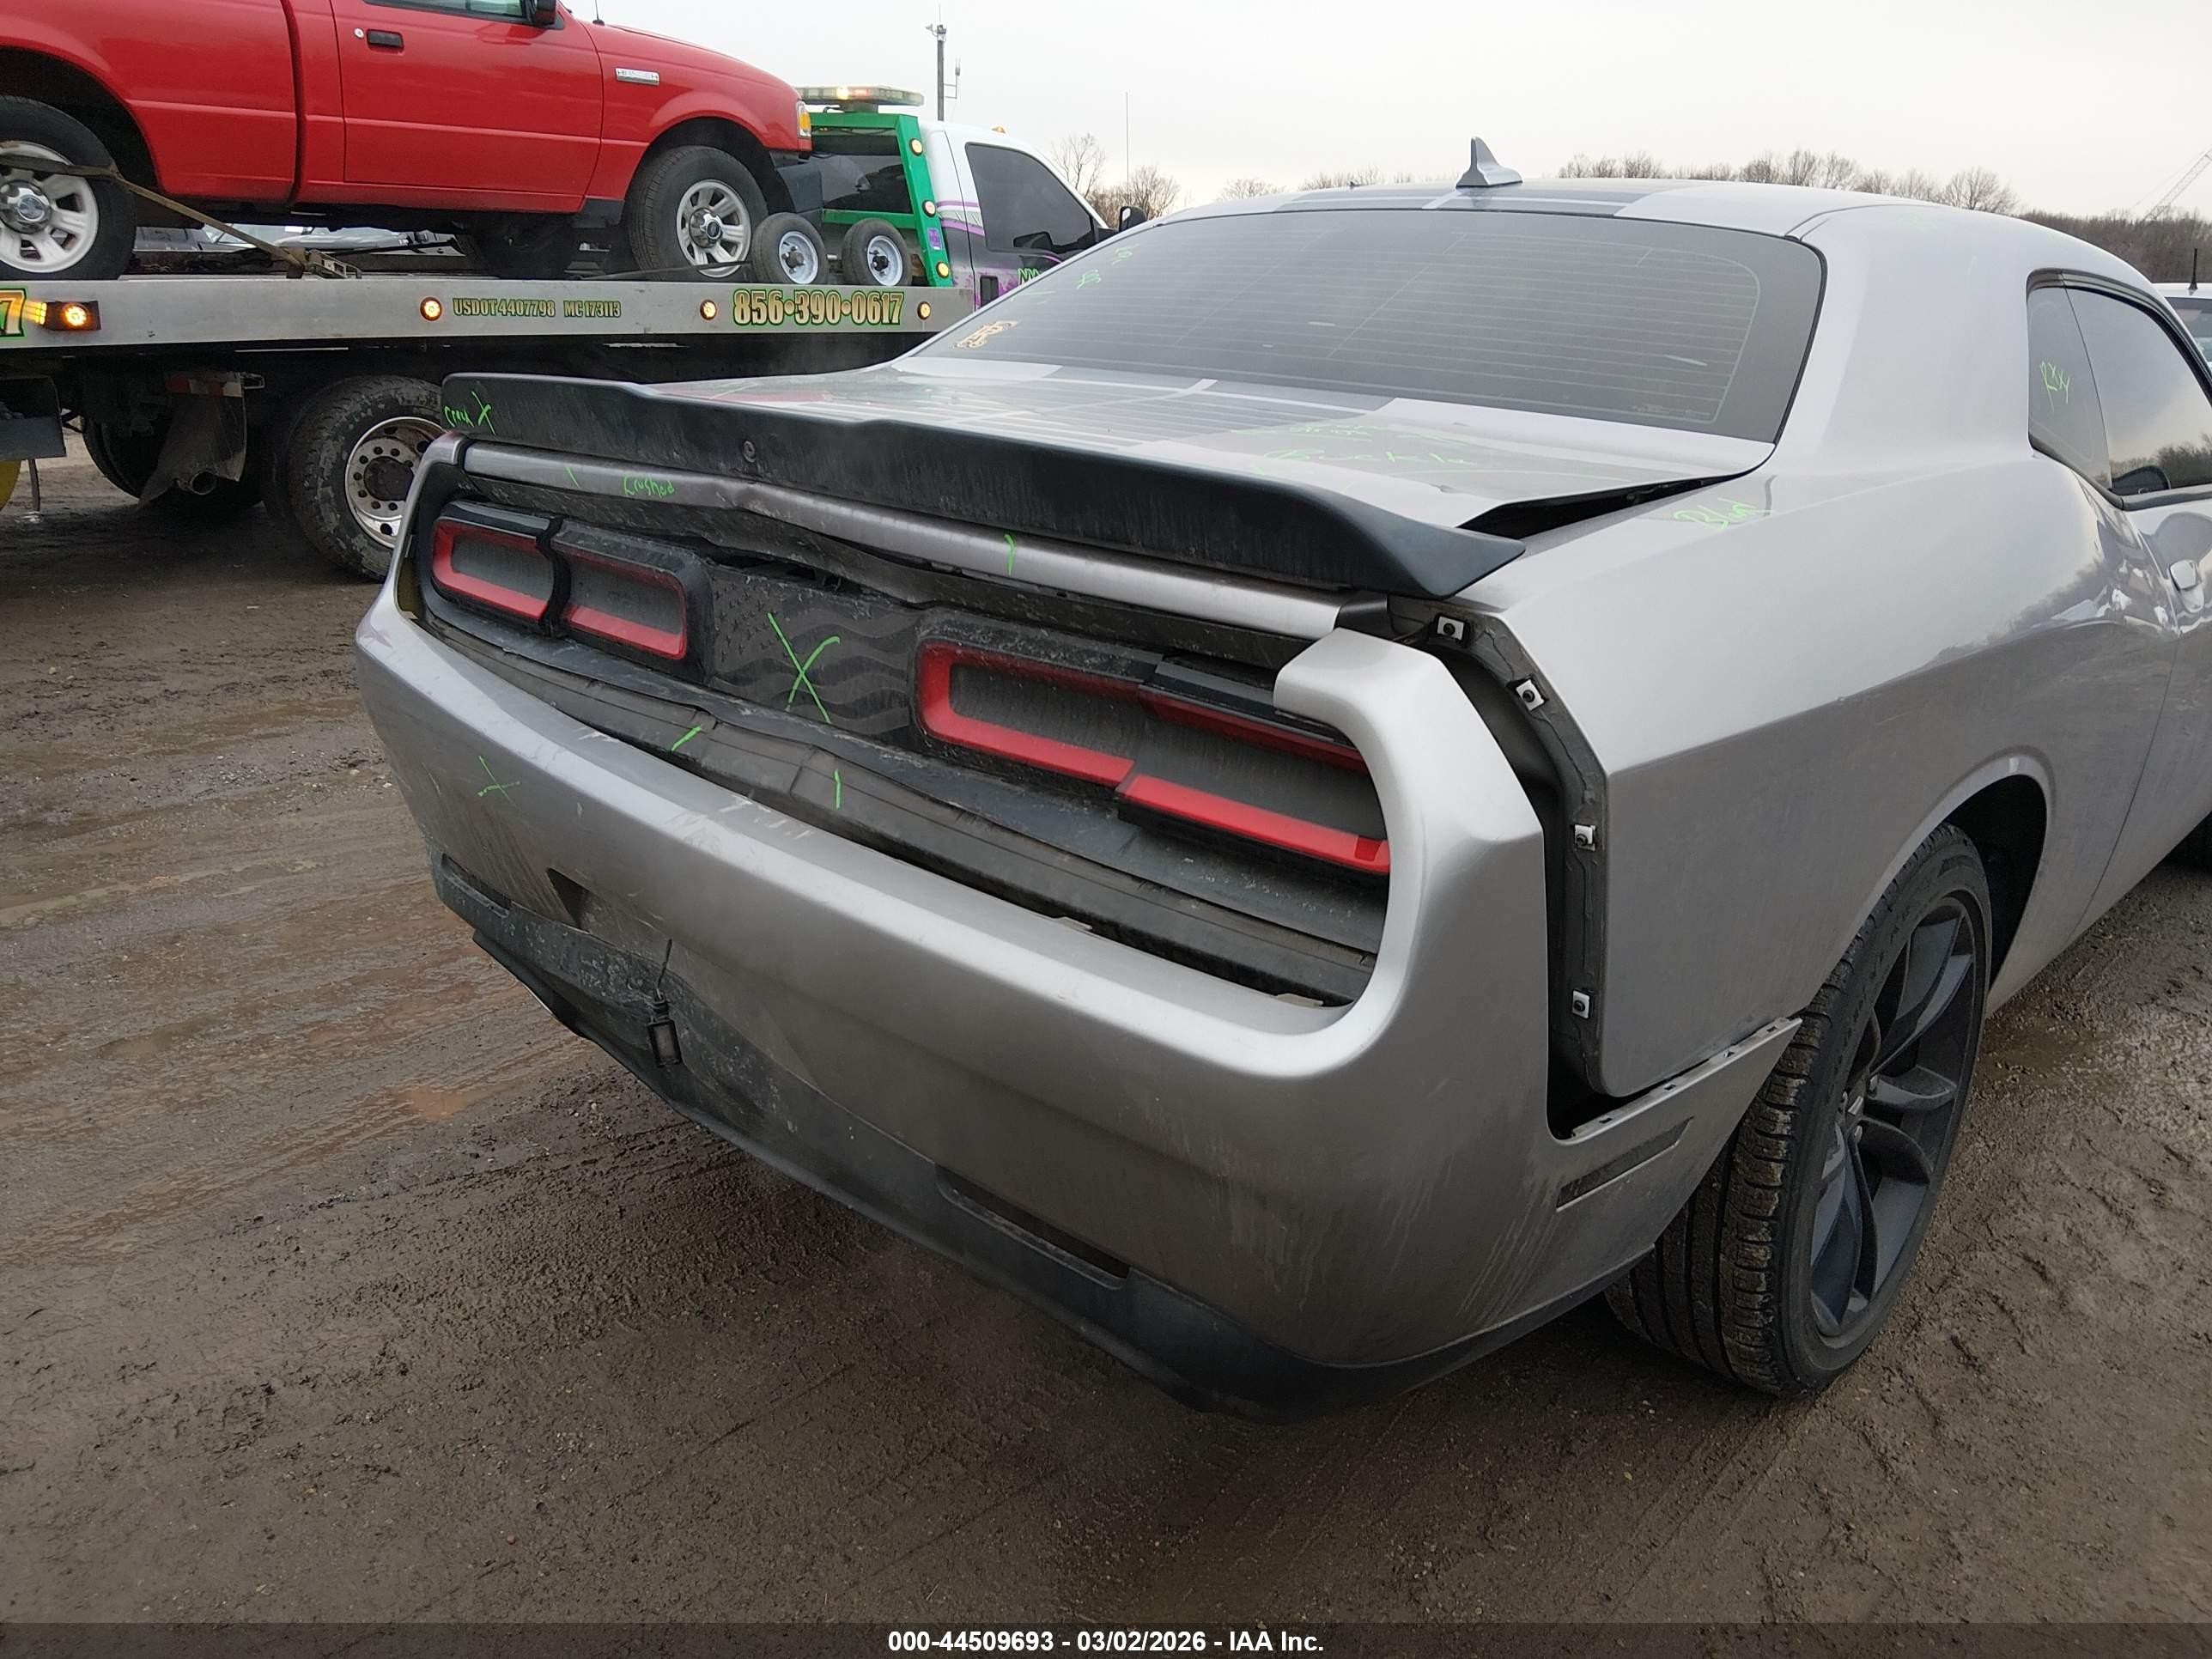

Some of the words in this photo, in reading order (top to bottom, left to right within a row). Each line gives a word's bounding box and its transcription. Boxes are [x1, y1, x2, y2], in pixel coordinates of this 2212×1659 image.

[497, 299, 556, 317] 4407798
[563, 301, 583, 317] MC
[583, 301, 622, 317] 173113
